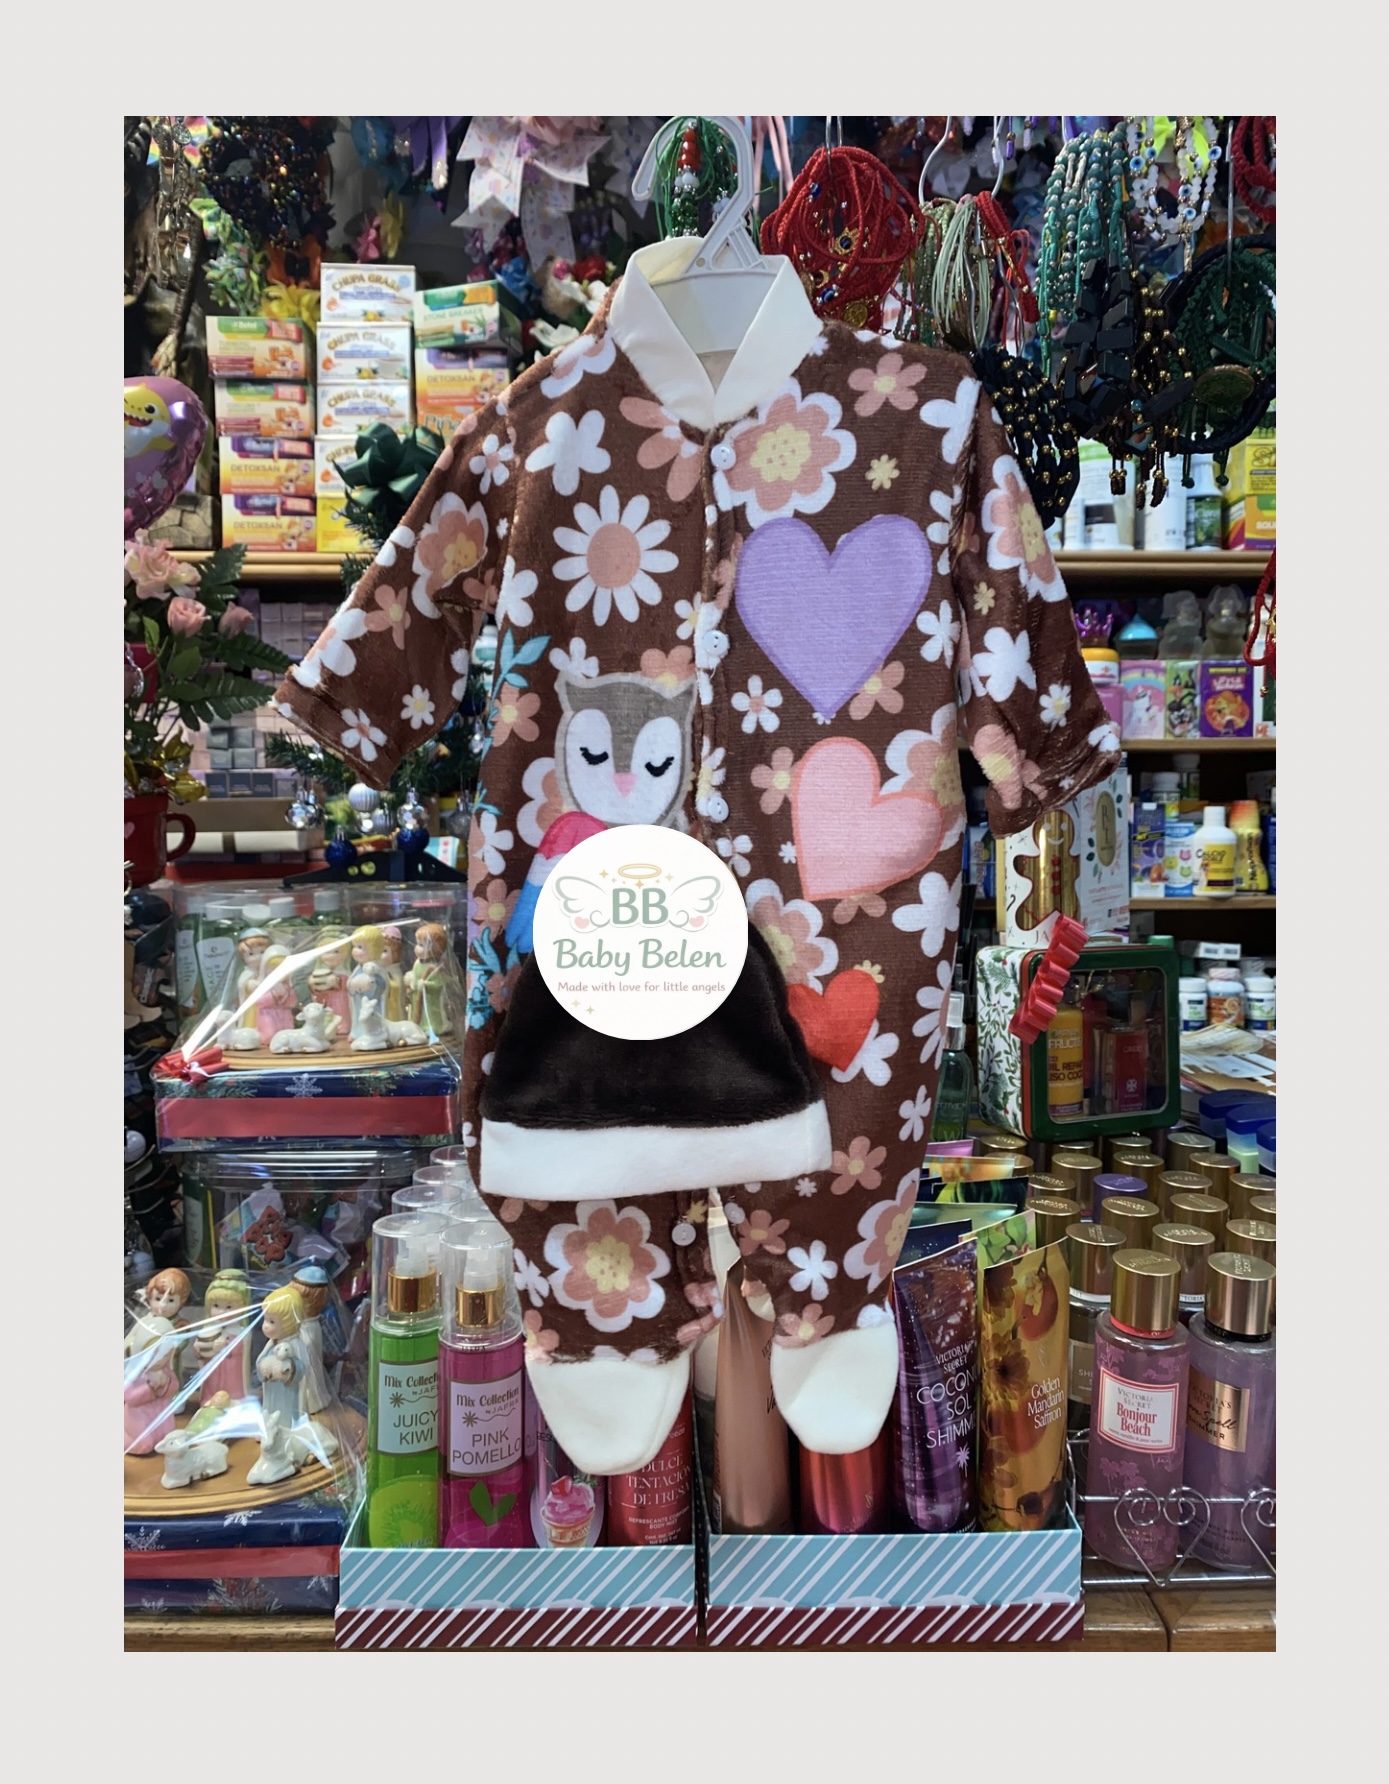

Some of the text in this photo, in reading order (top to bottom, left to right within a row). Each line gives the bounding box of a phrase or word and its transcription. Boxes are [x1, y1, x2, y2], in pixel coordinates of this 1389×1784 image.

[384, 1374, 402, 1389] Mix
[1031, 1377, 1061, 1400] Golden
[456, 1386, 519, 1408] Mix Collection
[491, 1399, 519, 1414] JAFRA
[946, 1392, 972, 1421] SOL
[1027, 1390, 1065, 1417] Mandarin
[393, 1409, 438, 1429] JUICY
[1034, 1407, 1062, 1430] Saffron
[1116, 1401, 1158, 1425] Bonjour
[399, 1427, 433, 1446] KIWI
[471, 1427, 509, 1448] PINK
[1120, 1417, 1152, 1437] Beach
